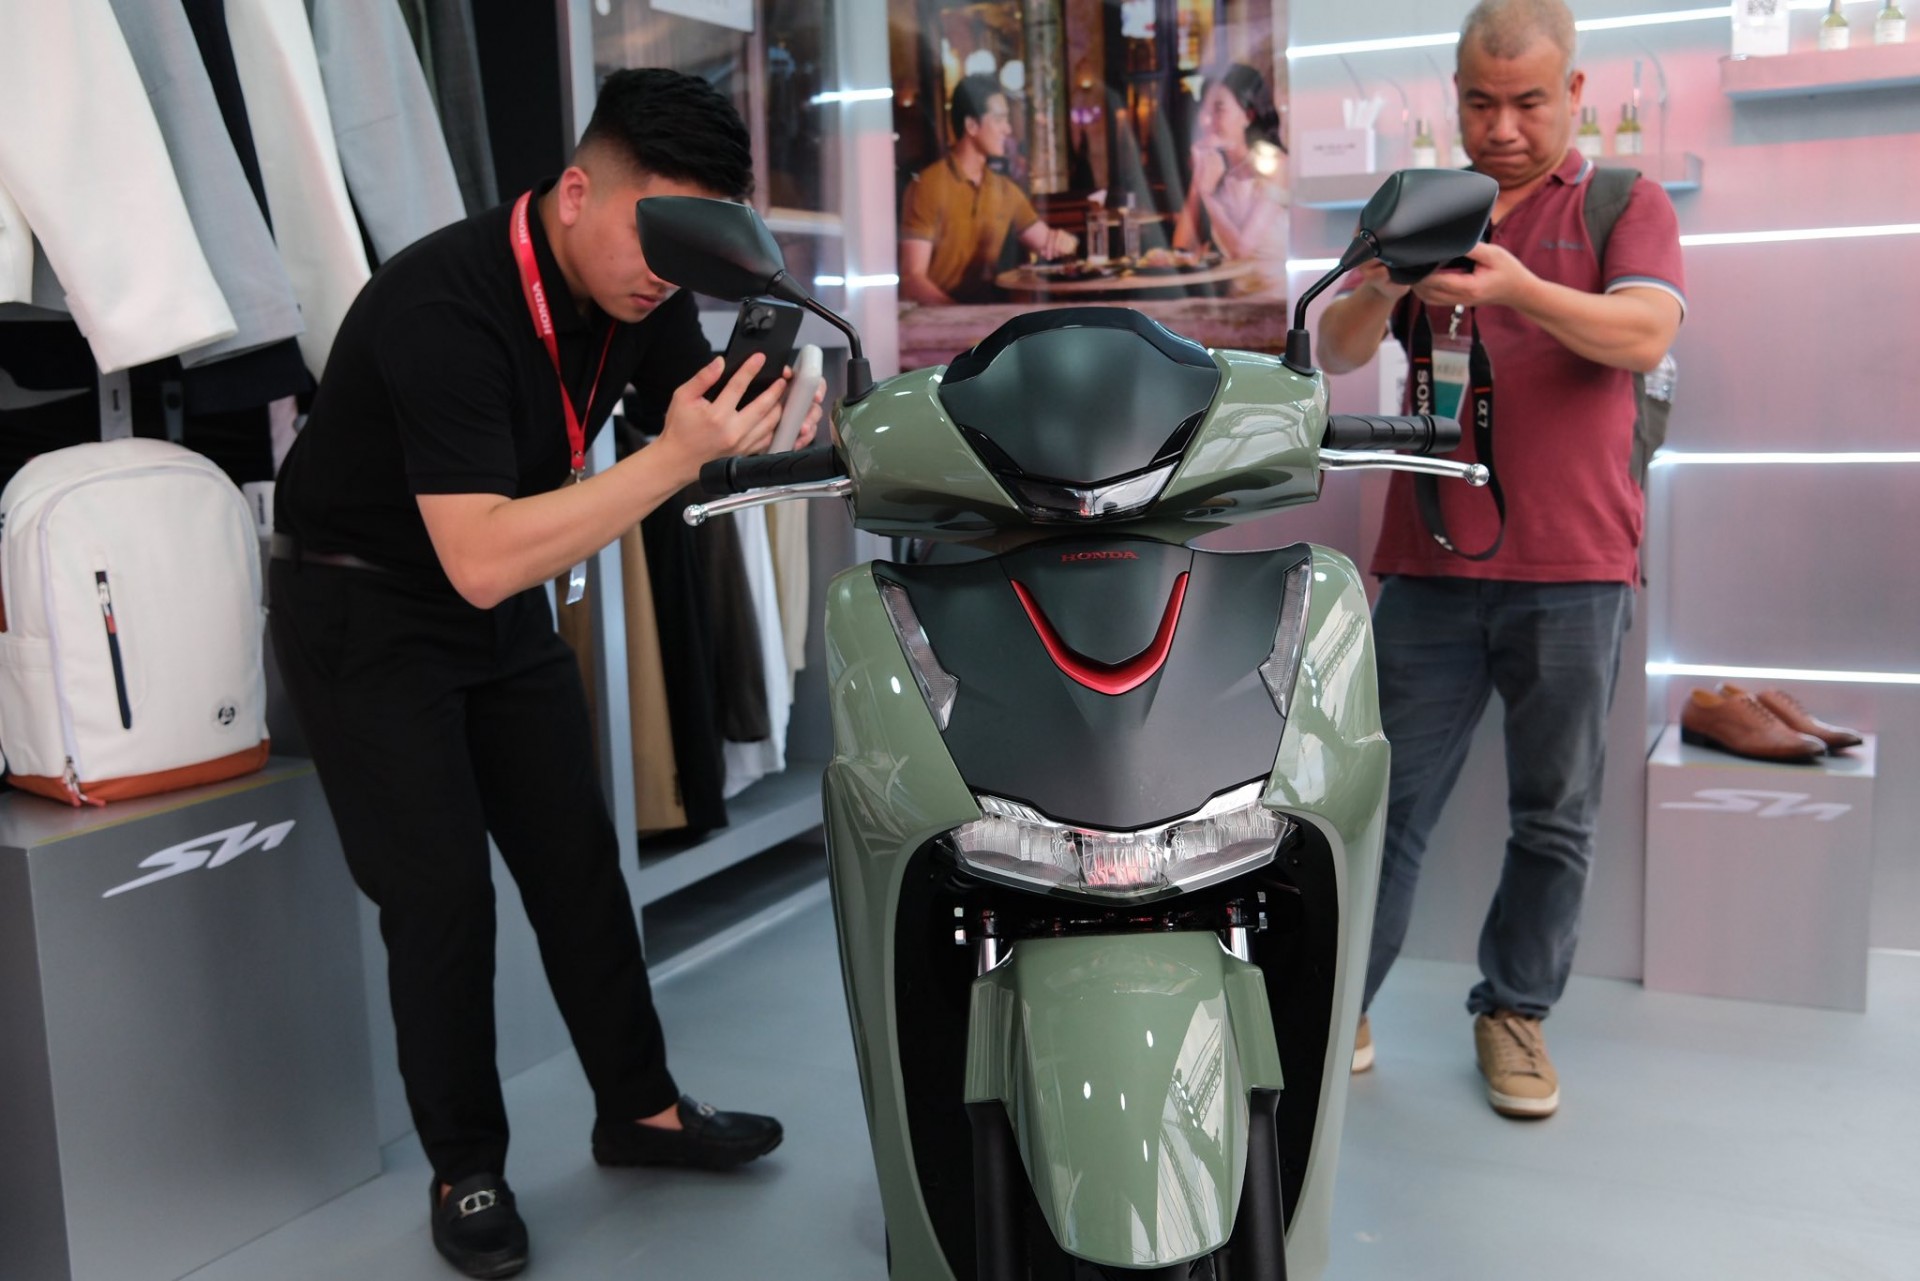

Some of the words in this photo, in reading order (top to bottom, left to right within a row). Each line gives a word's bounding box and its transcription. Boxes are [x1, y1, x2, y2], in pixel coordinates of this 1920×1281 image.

[532, 281, 552, 335] HONDA
[1417, 369, 1430, 415] SON
[1061, 550, 1139, 562] HONDA
